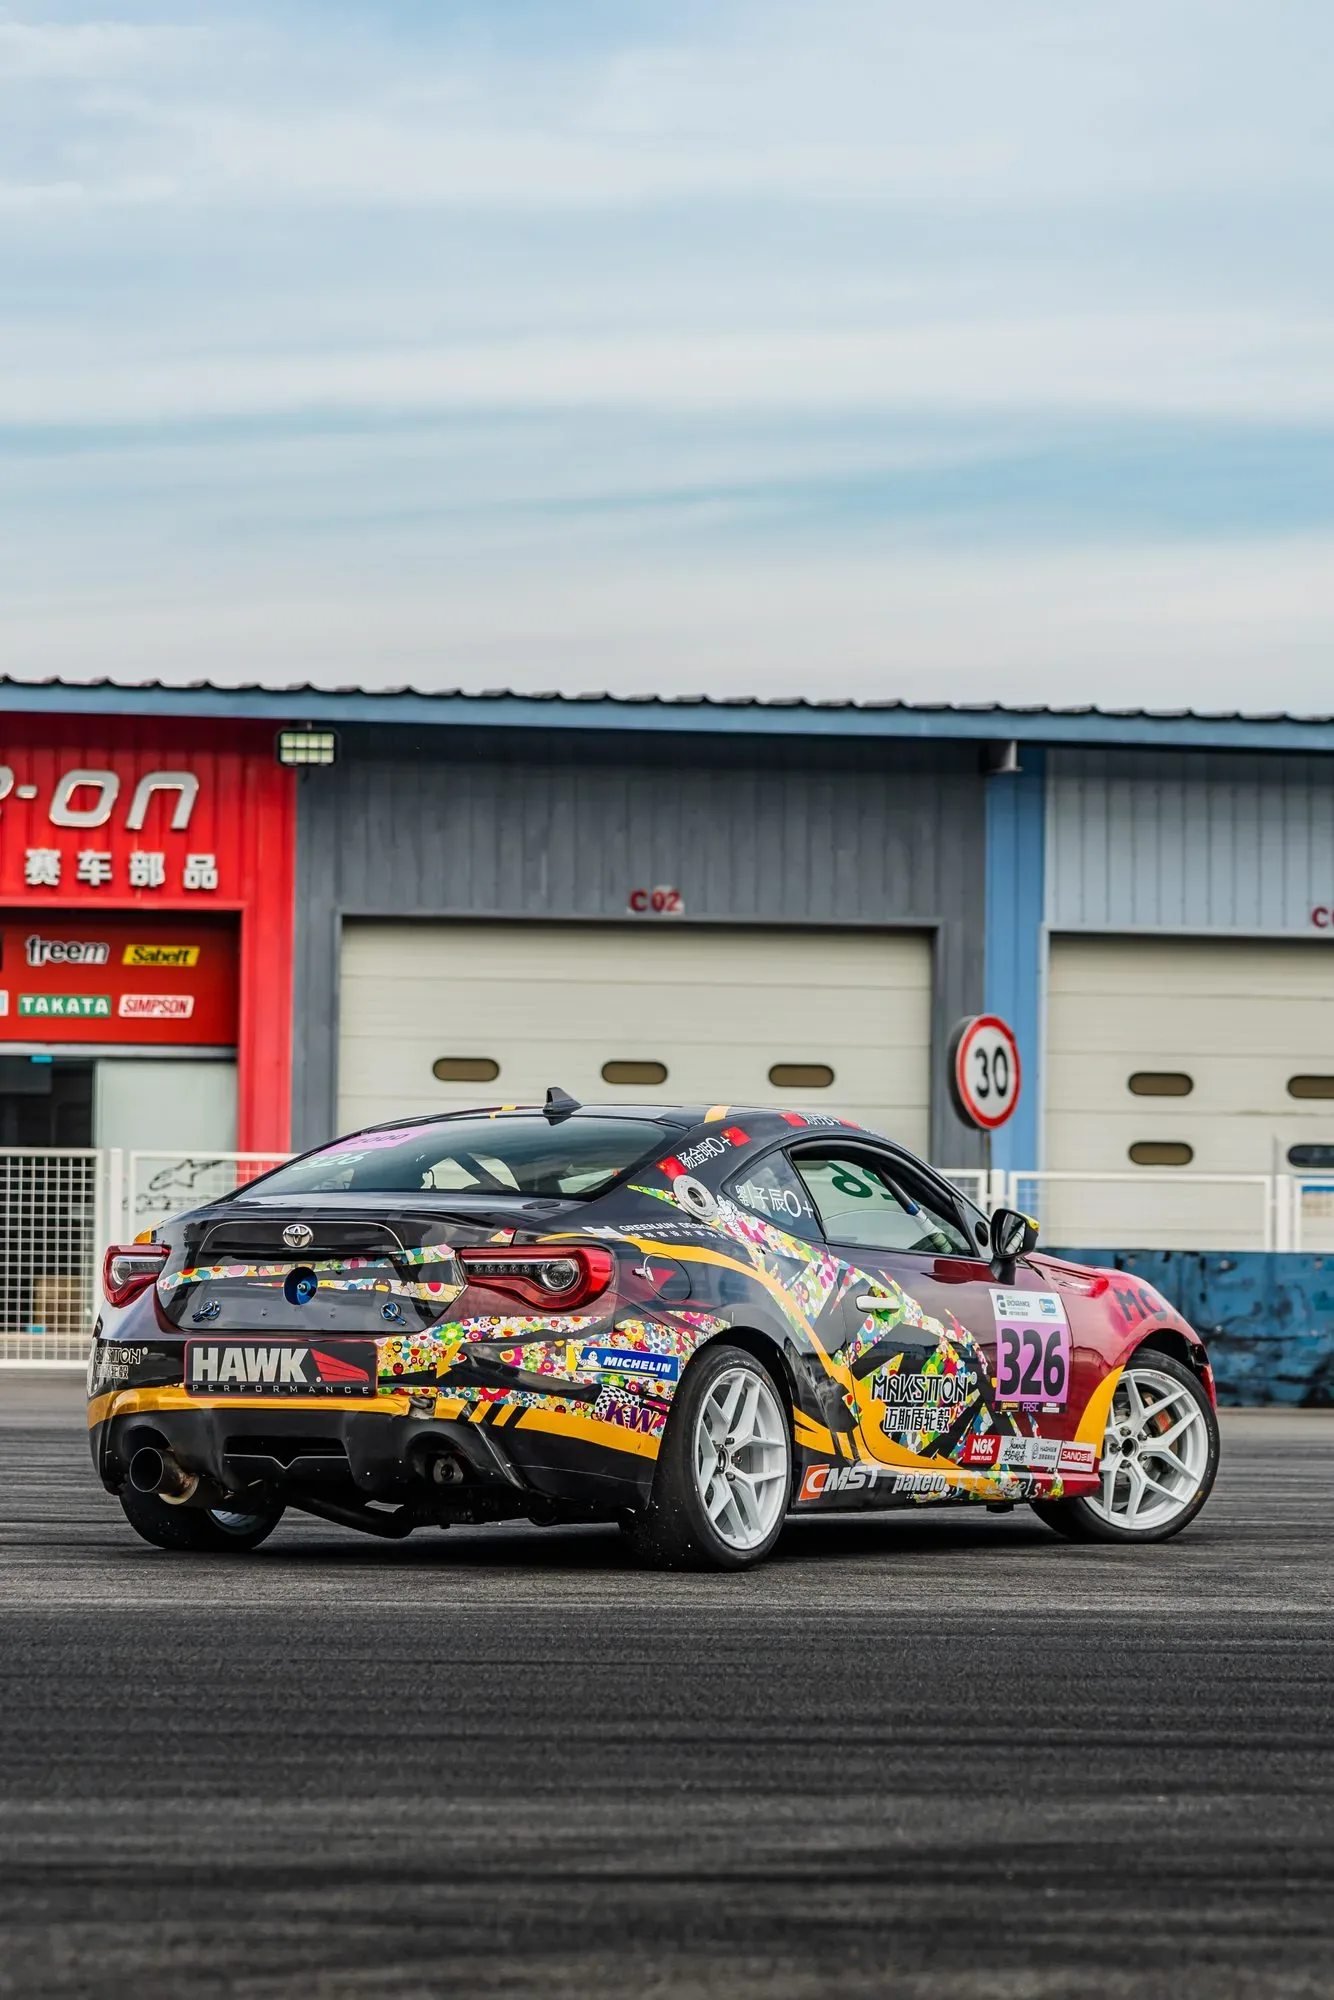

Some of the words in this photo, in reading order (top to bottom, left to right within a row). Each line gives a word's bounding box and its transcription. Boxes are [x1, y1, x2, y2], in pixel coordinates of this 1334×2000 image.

[25, 848, 218, 889] 赛车部品
[1311, 905, 1334, 928] C
[28, 936, 109, 966] freem
[22, 997, 108, 1014] TAKATA
[124, 1000, 189, 1014] SIMPSON
[975, 1046, 1008, 1099] 30
[192, 1347, 309, 1383] HAWK
[603, 1356, 672, 1373] MICHELIN
[1000, 1328, 1065, 1396] 326
[192, 1385, 370, 1394] PERFORMANCE
[602, 1400, 660, 1435] KW
[883, 1407, 951, 1433] 迈斯盾轮毂
[971, 1438, 996, 1454] NGK
[806, 1464, 882, 1493] CMST
